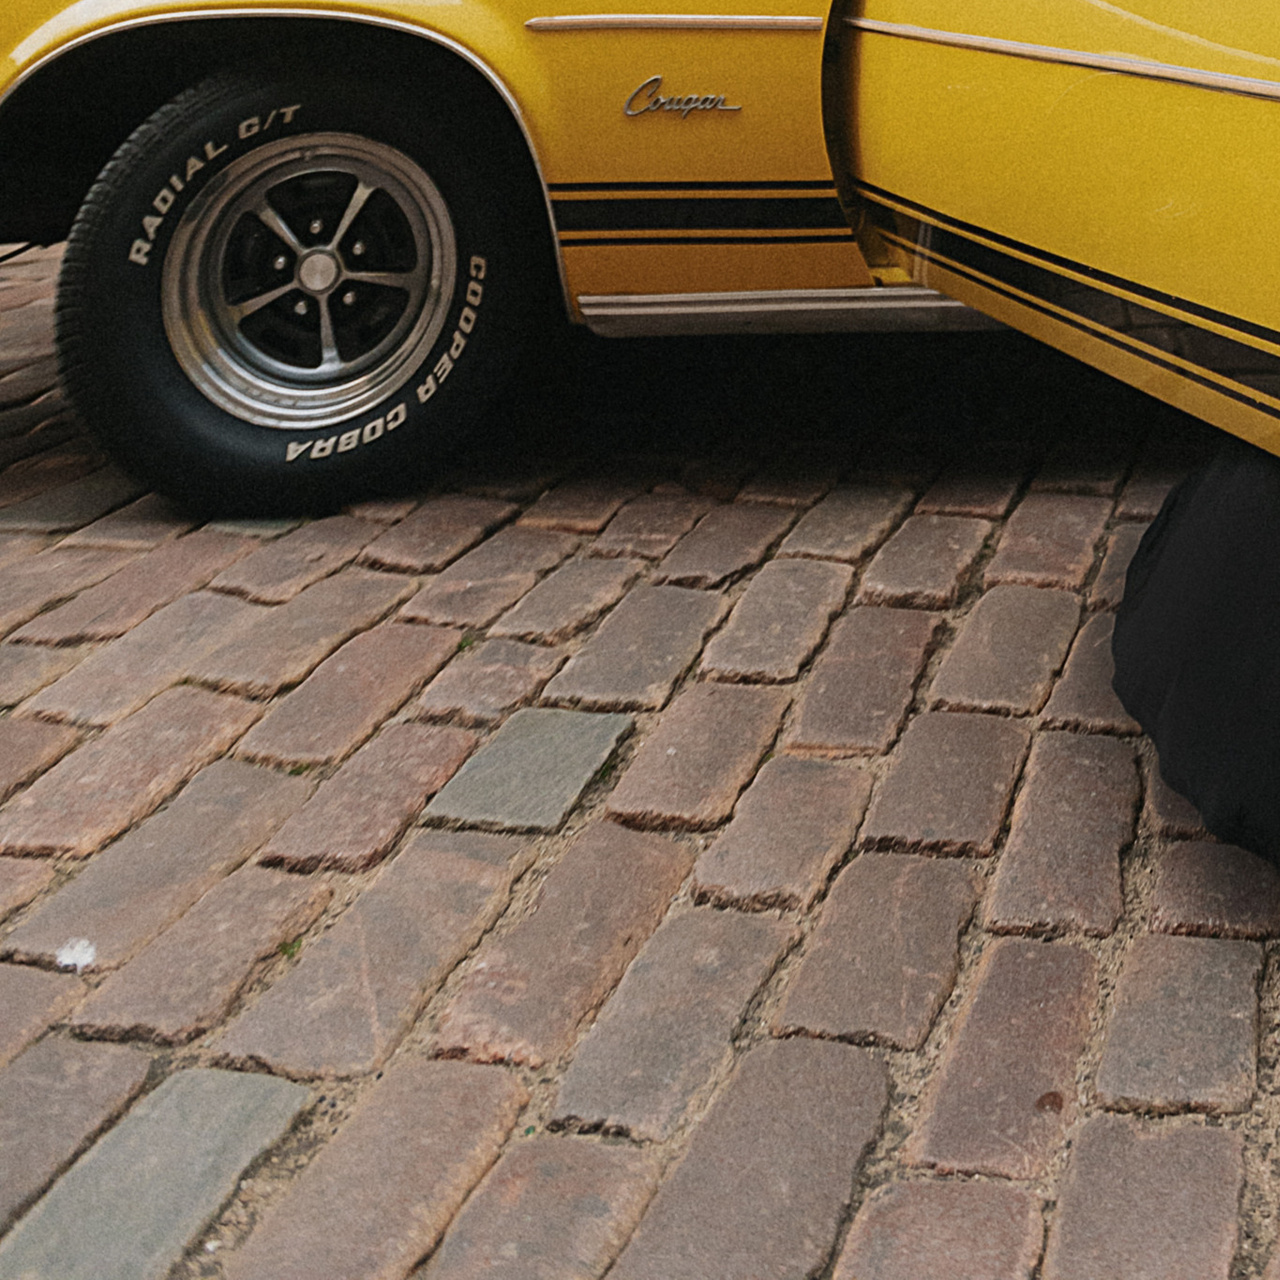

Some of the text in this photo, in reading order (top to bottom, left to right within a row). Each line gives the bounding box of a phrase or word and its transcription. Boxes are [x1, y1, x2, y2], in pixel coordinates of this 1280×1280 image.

[623, 74, 742, 120] Cougar
[127, 103, 302, 267] RADIAL G/T
[284, 255, 487, 463] COOPER COBRA
